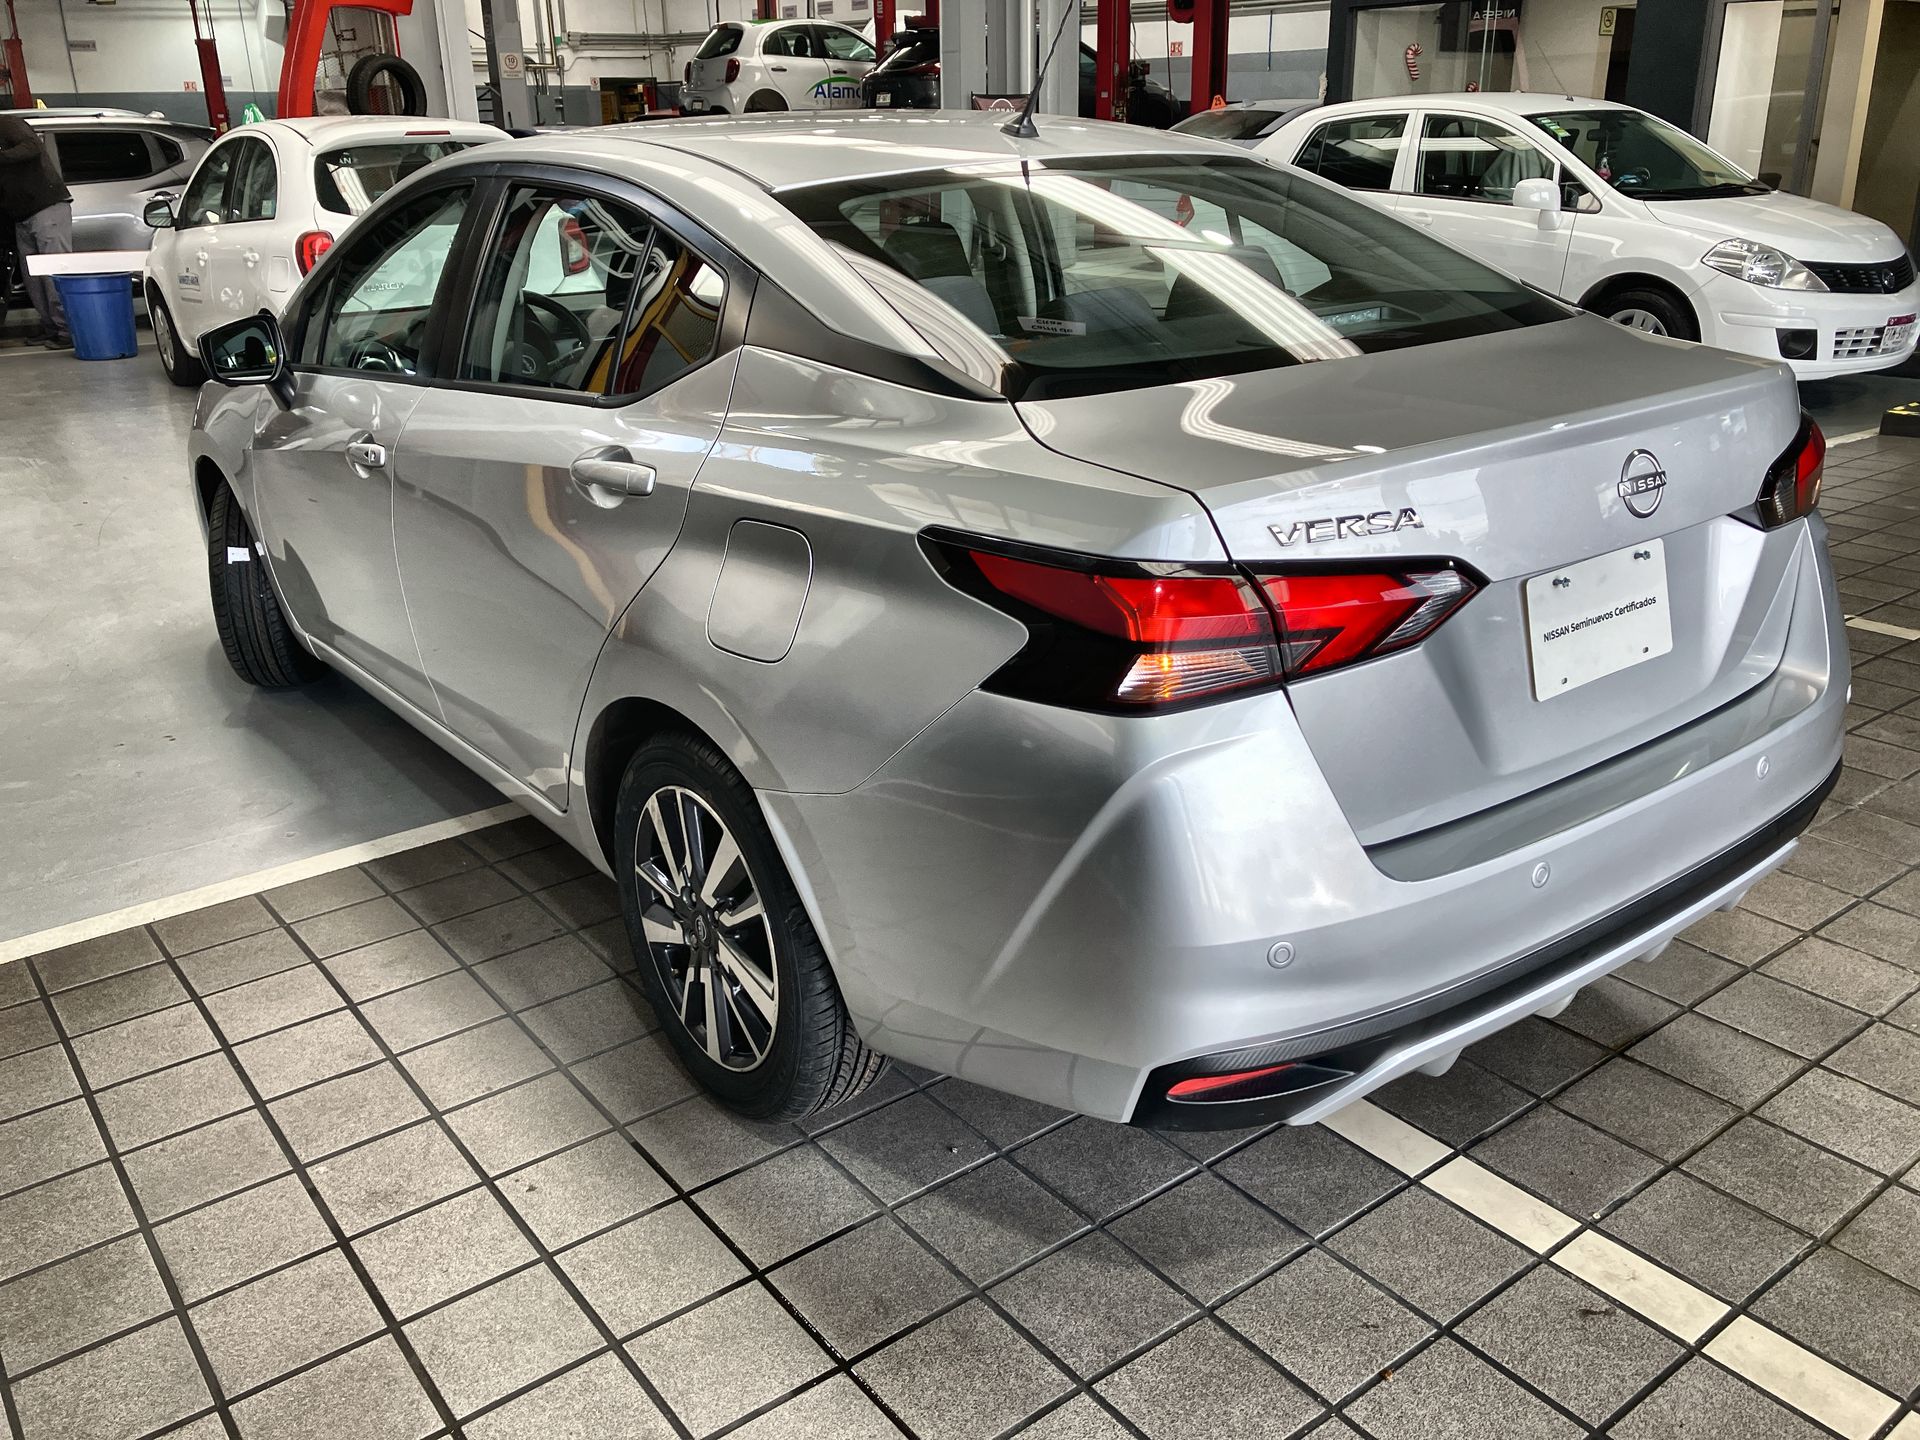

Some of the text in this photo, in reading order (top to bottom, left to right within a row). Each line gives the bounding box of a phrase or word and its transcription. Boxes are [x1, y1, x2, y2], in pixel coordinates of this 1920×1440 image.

[1618, 473, 1667, 497] NISSAN
[1267, 507, 1425, 547] VERSA
[1543, 596, 1657, 643] NISSAN Seminuevos Certificados
